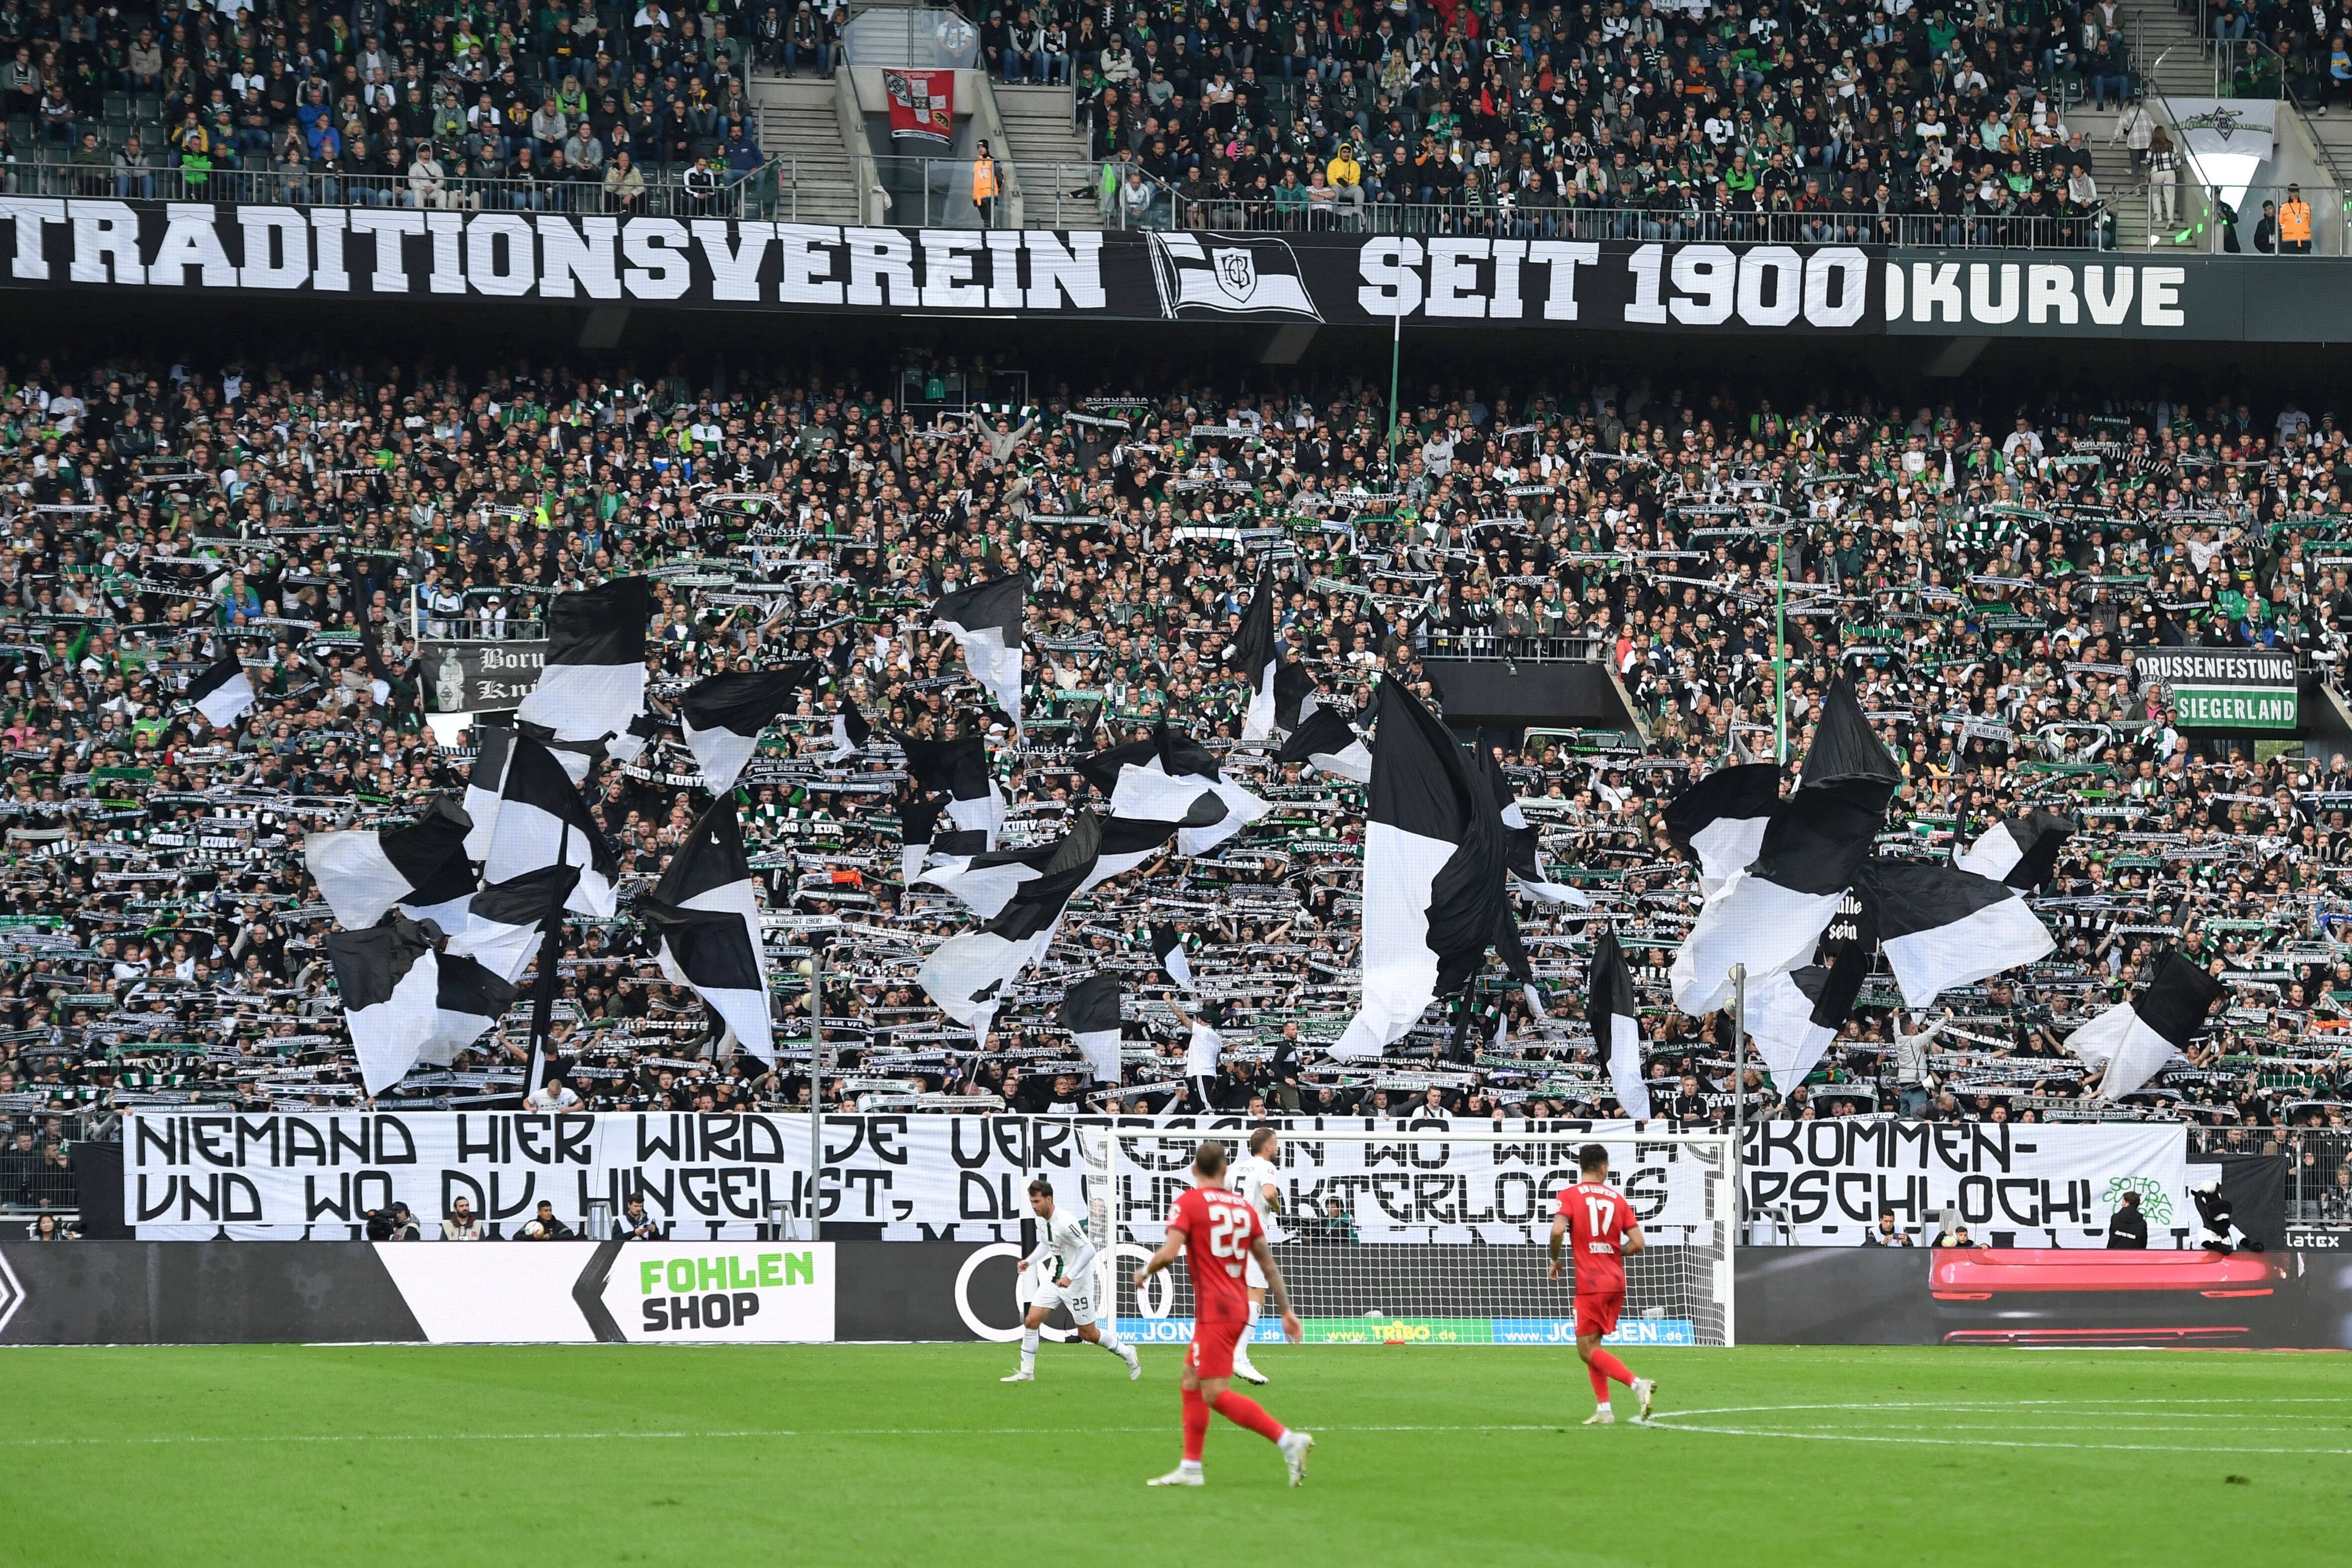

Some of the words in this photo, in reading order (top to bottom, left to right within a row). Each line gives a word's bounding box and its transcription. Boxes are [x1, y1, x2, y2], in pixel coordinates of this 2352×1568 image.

[0, 197, 1106, 309] TRADITIONSVEREIN
[1358, 236, 1599, 320] SEIT
[1625, 245, 1869, 326] 1900
[2179, 697, 2295, 721] SIEGERLAND
[1294, 842, 1358, 853] BORUSSIA
[797, 855, 870, 865] TRADITIONSVEREIN
[1829, 920, 1857, 940] sein
[2263, 955, 2331, 963] TRADITIONSVEREIN
[1201, 989, 1275, 998] TRADITIONSVEREIN
[1305, 1066, 1387, 1075] TRADITIONSVEREIN
[1095, 1082, 1177, 1098] TRADITIONSVEREIN
[1955, 1086, 2024, 1095] TRADITIONSVEREIN
[136, 1115, 416, 1167] NIEMAND
[457, 1114, 594, 1164] HIER
[637, 1114, 784, 1164] WIRD
[824, 1116, 907, 1165] JE
[1365, 1118, 1449, 1169] WO
[305, 1170, 393, 1222] WO
[440, 1169, 535, 1222] DU
[1585, 1196, 1615, 1237] 17
[1208, 1204, 1251, 1260] 22
[2287, 1232, 2339, 1247] latex
[640, 1251, 814, 1295] FOHLEN
[643, 1292, 759, 1332] SHOP
[1072, 1297, 1088, 1311] 29
[1505, 1332, 1542, 1342] www.
[1547, 1322, 1657, 1341] JOGEN
